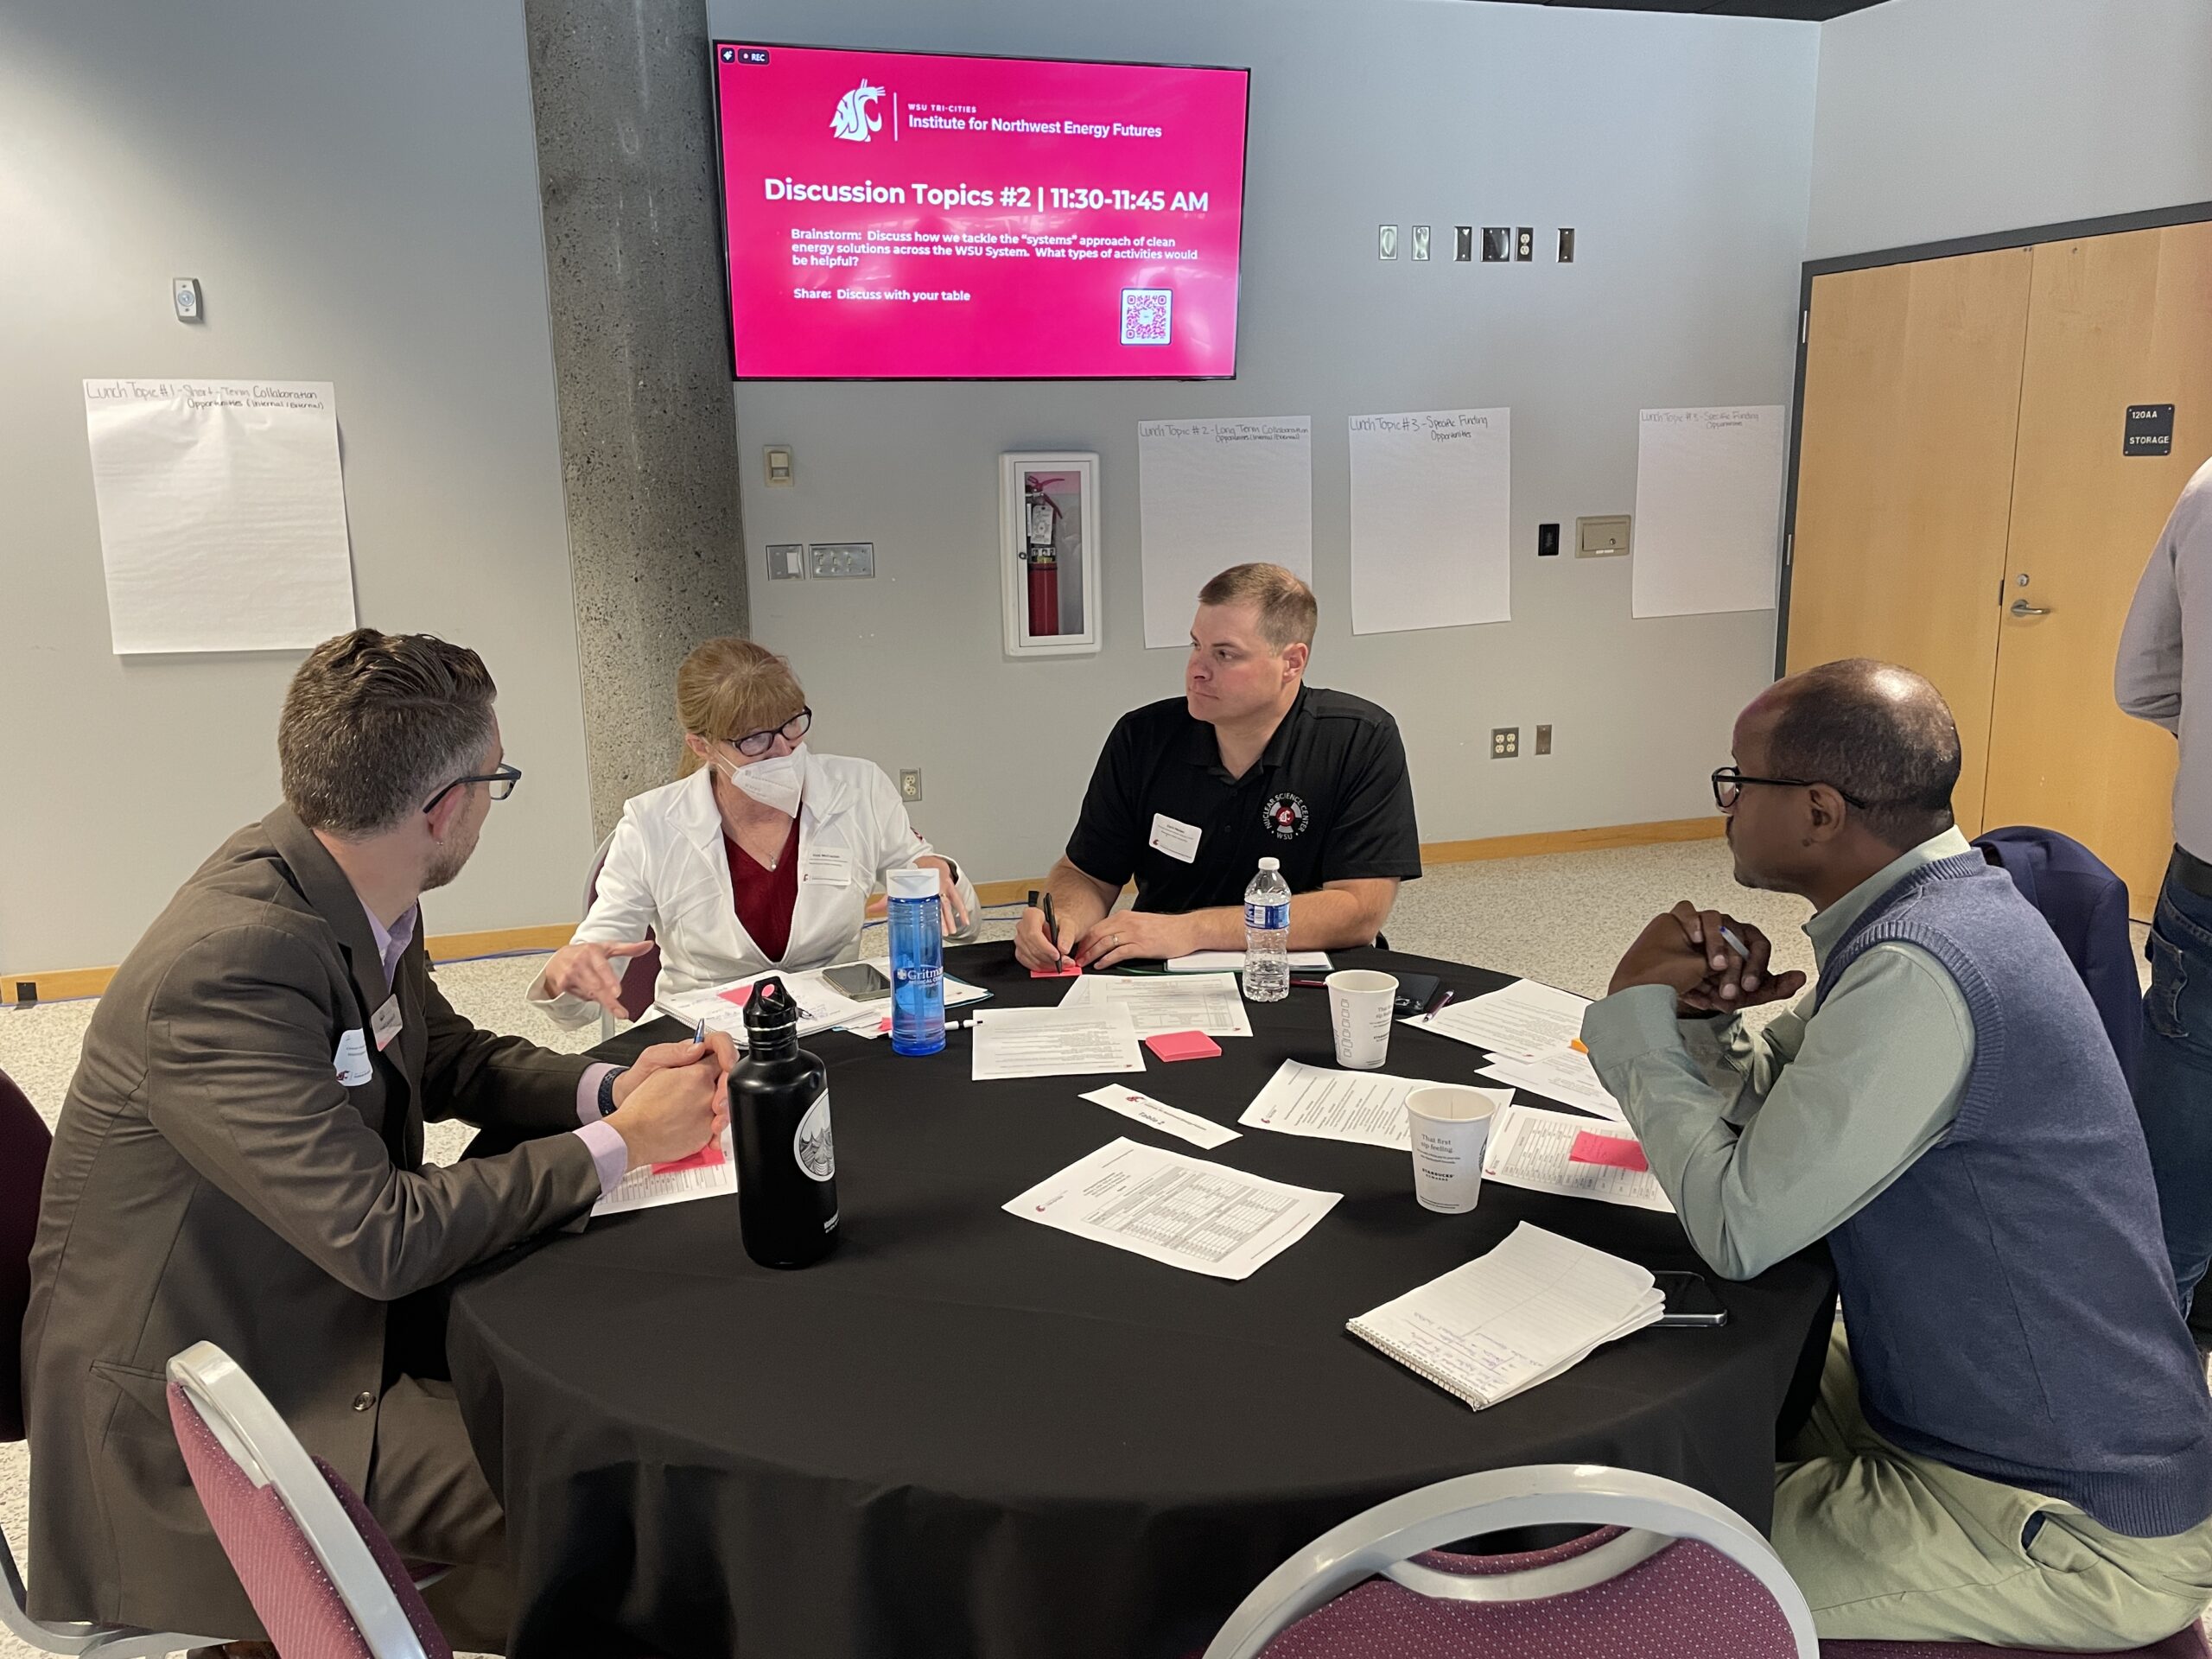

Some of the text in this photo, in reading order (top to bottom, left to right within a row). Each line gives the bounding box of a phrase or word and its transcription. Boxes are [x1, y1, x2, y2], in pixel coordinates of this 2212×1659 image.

[751, 53, 766, 62] REC
[908, 103, 977, 114] WSU TRI-CITIES
[908, 113, 1162, 139] Institute for Northwest Energy Futures
[765, 176, 906, 204] Discussion
[912, 182, 995, 211] Topics
[1000, 187, 1032, 207] #2
[1051, 188, 1166, 211] 11:30-11:45
[1170, 192, 1209, 212] AM
[791, 228, 862, 241] Brainstorm:
[867, 230, 913, 242] Discuss
[914, 231, 941, 243] how
[943, 233, 961, 244] we
[963, 232, 998, 244] tackle
[1000, 233, 1020, 245] the
[1079, 237, 1131, 248] approach
[1133, 236, 1146, 247] of
[1147, 237, 1176, 248] clean
[791, 243, 1198, 261] energy solutions across the WSU System. What types of activities would
[791, 255, 860, 269] be helpful?
[793, 288, 971, 302] Share: Discuss with your table
[86, 380, 128, 399] Lunch
[125, 381, 159, 401] Topic
[253, 385, 318, 399] Collaboration
[2132, 410, 2158, 419] 120AA
[1350, 416, 1376, 432] Lunch
[1375, 416, 1402, 433] Topic
[2129, 435, 2170, 445] STORAGE
[1262, 792, 1309, 832] NUCLEAR SCIENCE CENTER
